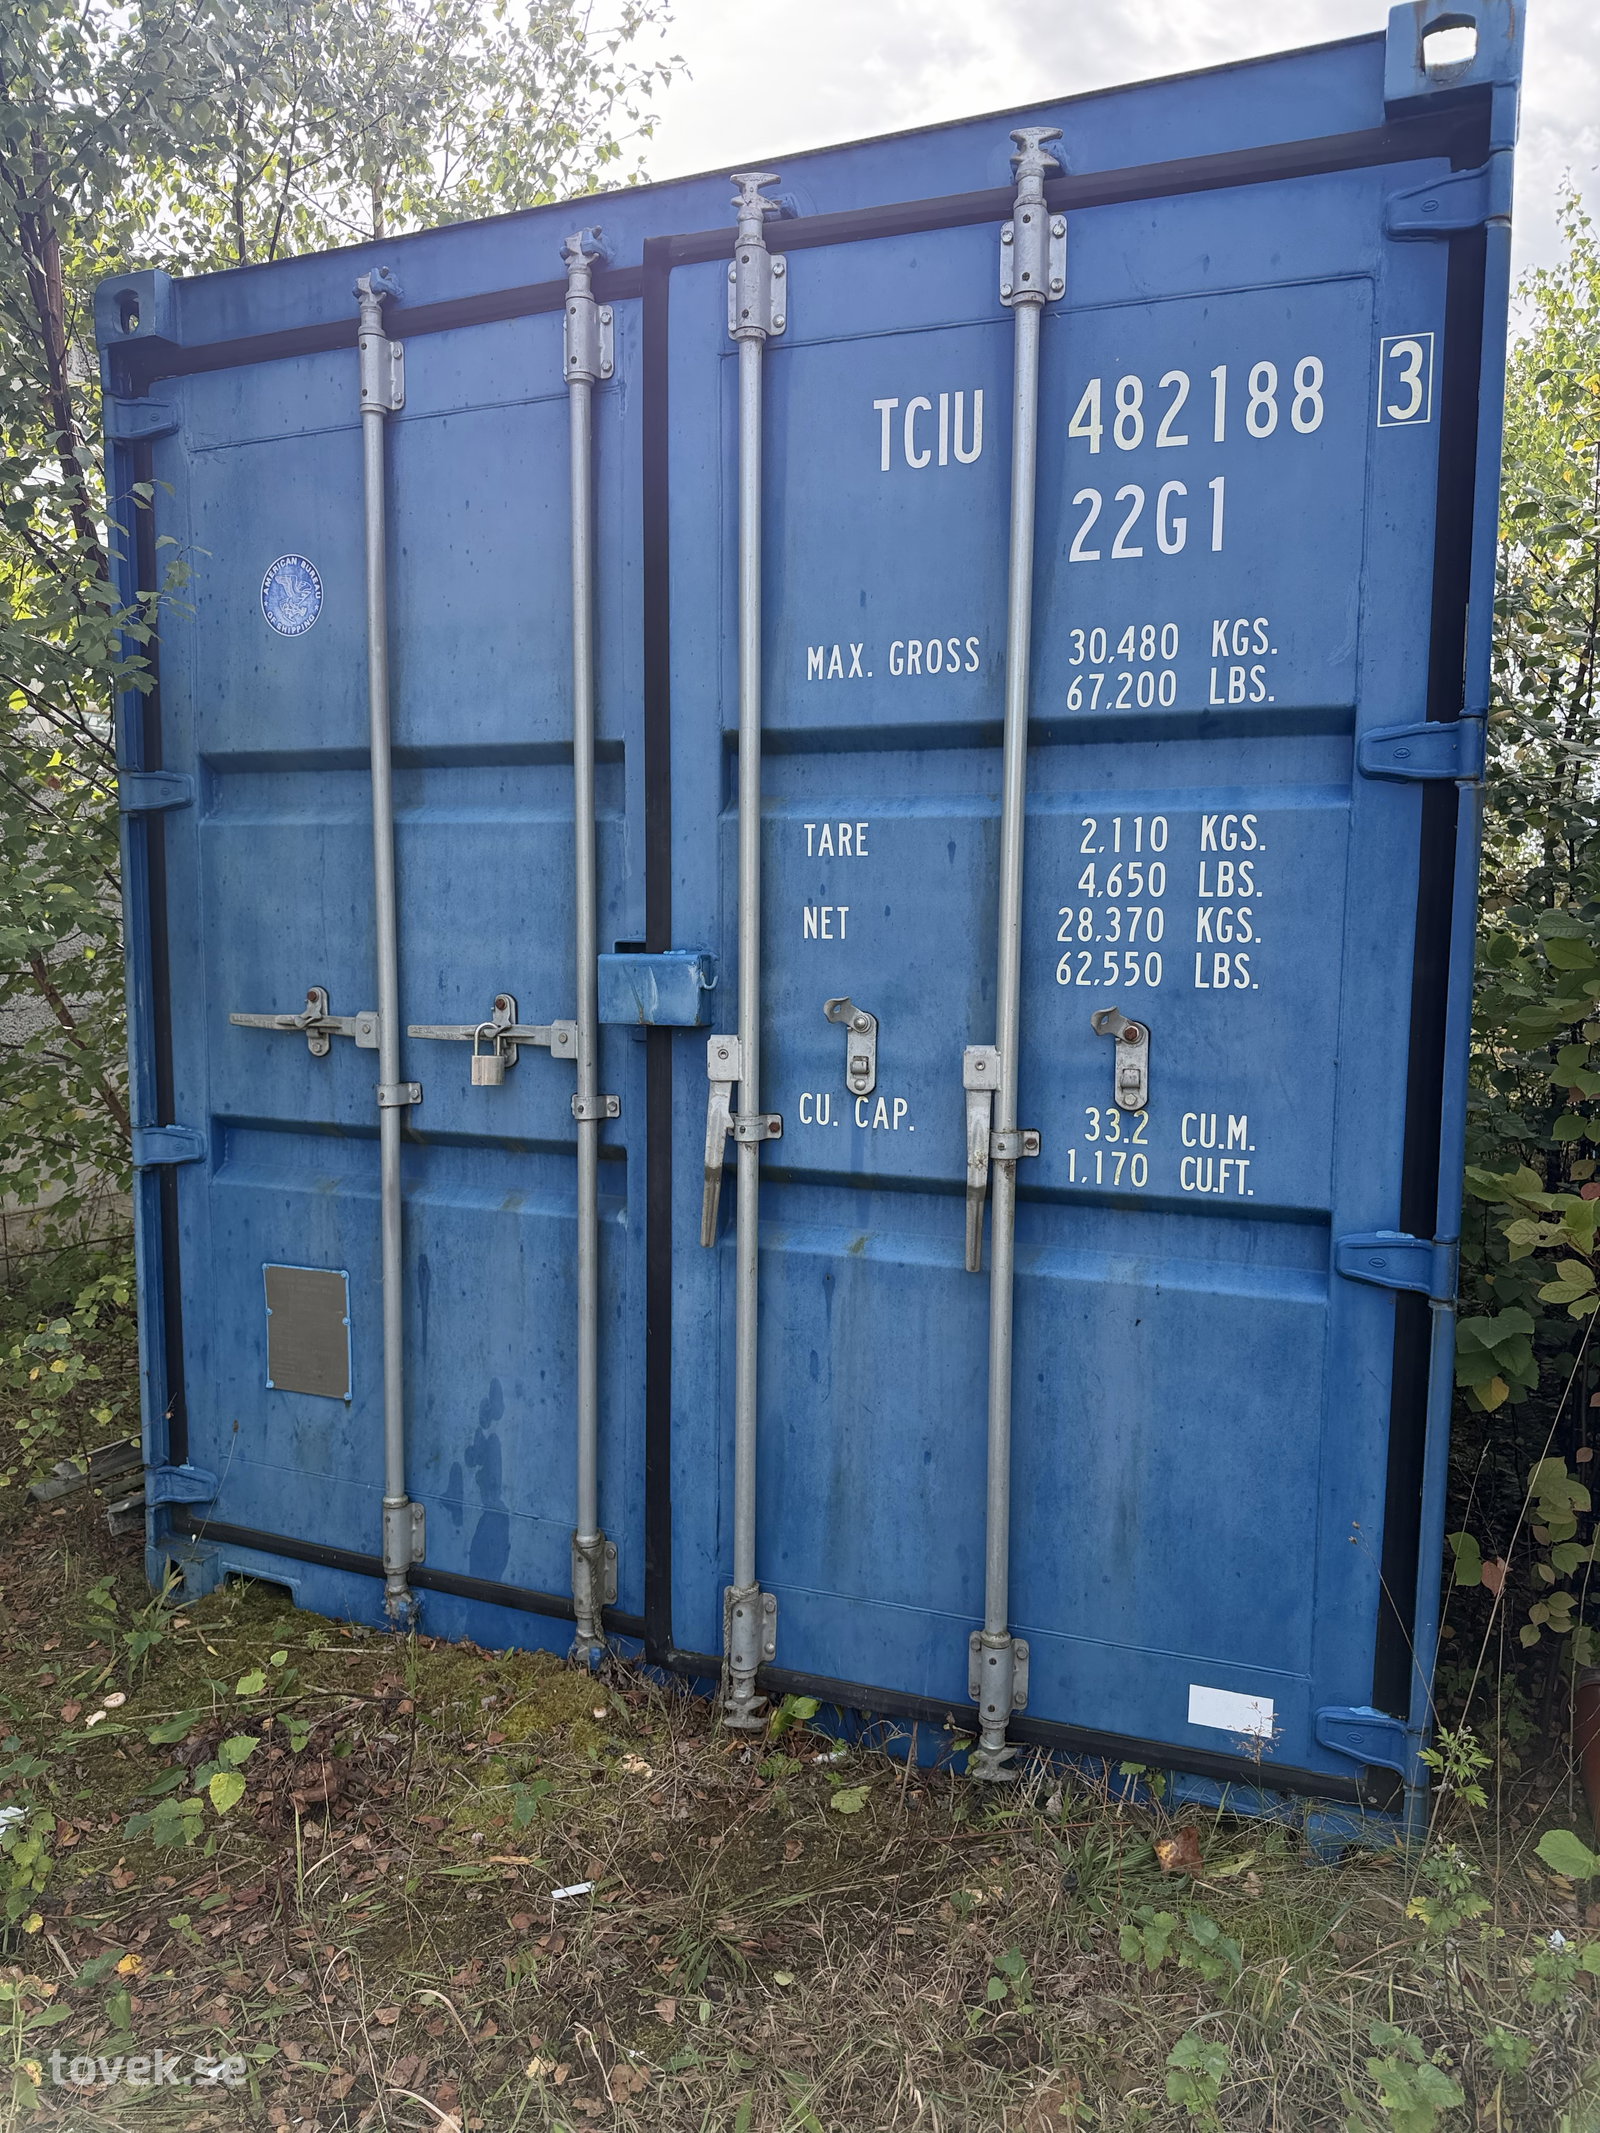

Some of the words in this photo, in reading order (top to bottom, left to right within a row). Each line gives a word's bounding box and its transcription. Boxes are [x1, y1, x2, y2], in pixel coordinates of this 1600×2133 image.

[873, 389, 984, 472] TCIU
[1068, 355, 1324, 454] 482188
[1387, 340, 1423, 420] 3
[1068, 476, 1225, 563] 22G1
[263, 557, 298, 596] AMERICAN
[300, 560, 321, 599] BUREAU
[267, 611, 277, 623] OF
[276, 614, 315, 634] SHIPPING
[807, 642, 873, 681] MAX.
[889, 636, 980, 676] GROSS
[1068, 622, 1179, 666] 30,480
[1211, 617, 1278, 657] KGS.
[1066, 669, 1177, 711] 67,200
[1209, 664, 1275, 705] LBS.
[803, 822, 869, 857] TARE
[1079, 815, 1168, 854] 2,110
[1200, 813, 1266, 852] KGS.
[1077, 861, 1166, 898] 4,650
[1198, 860, 1263, 898] LBS.
[803, 906, 850, 940] NET
[1056, 906, 1165, 943] 28,370
[1196, 906, 1262, 944] KGS.
[1056, 950, 1163, 988] 62,550
[1194, 952, 1259, 990] LBS.
[799, 1092, 839, 1127] CU.
[854, 1096, 915, 1132] CAP.
[1084, 1106, 1149, 1145] 33.2
[1181, 1112, 1256, 1152] CU.M.
[1067, 1148, 1148, 1188] 1,170
